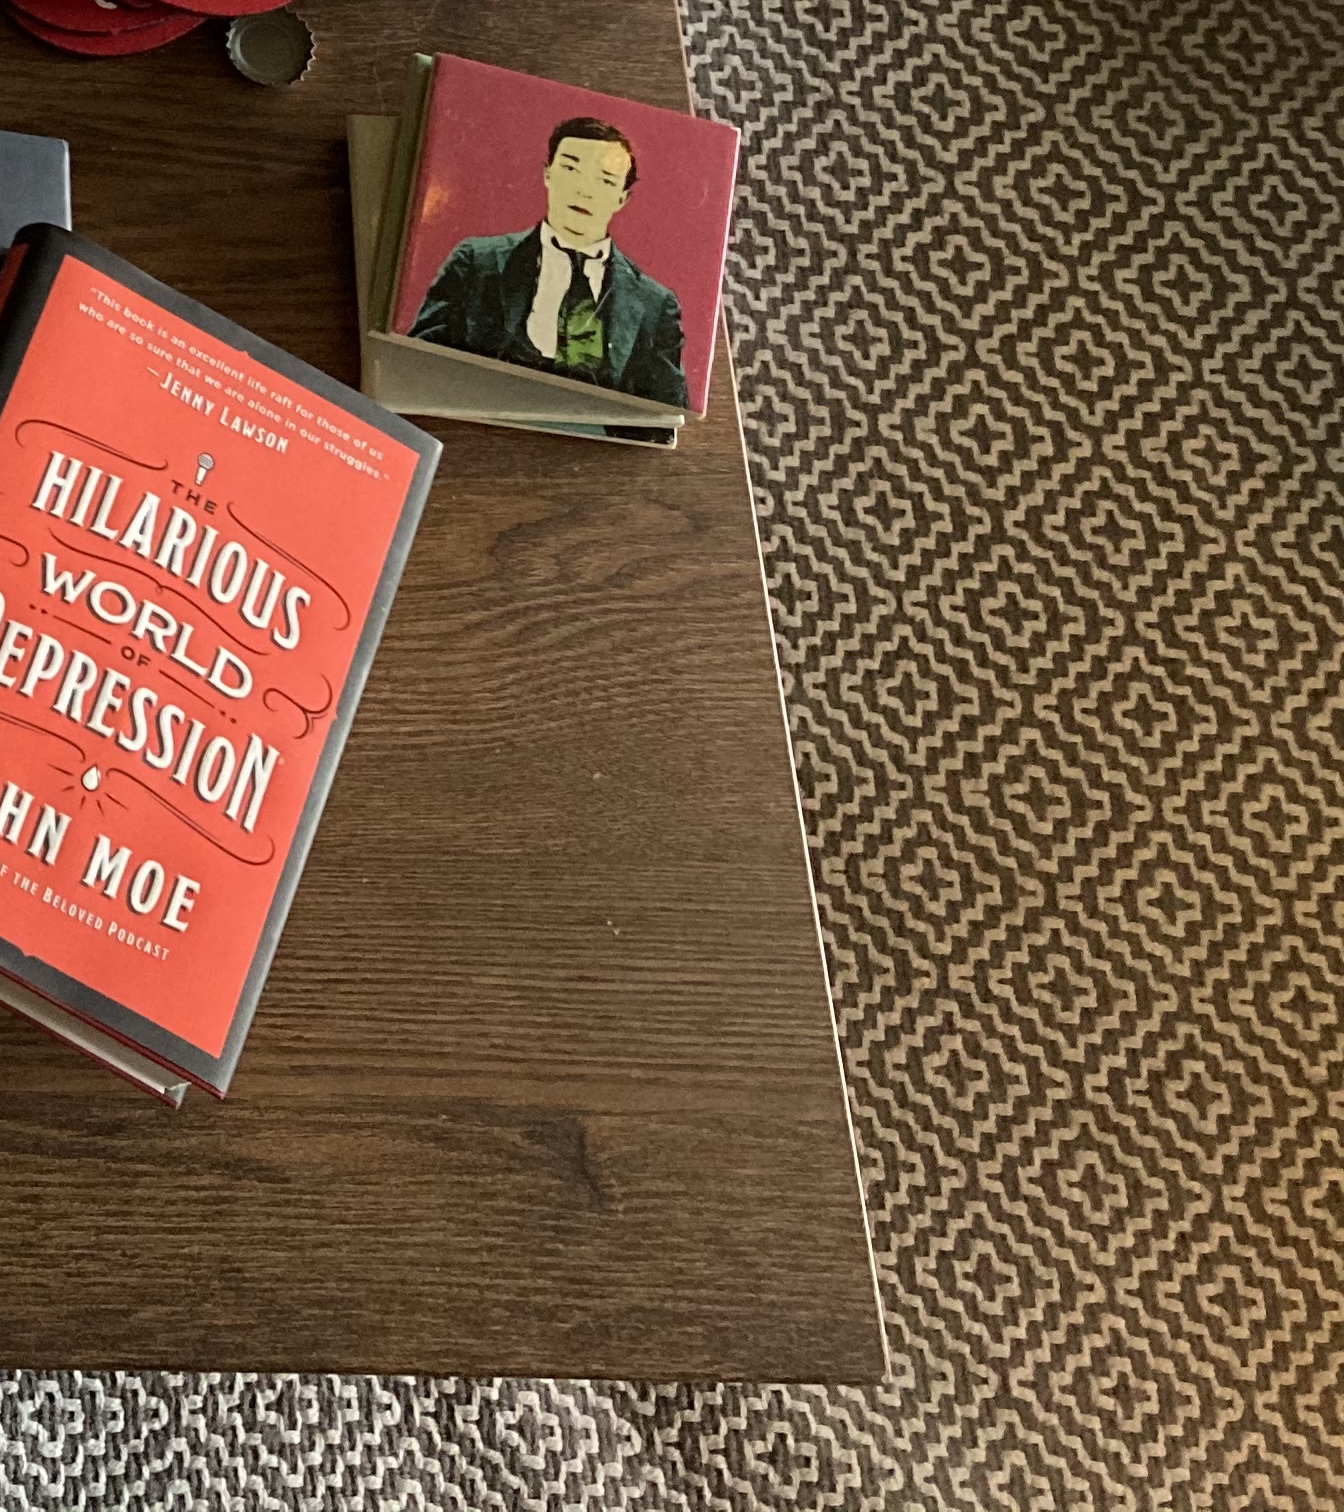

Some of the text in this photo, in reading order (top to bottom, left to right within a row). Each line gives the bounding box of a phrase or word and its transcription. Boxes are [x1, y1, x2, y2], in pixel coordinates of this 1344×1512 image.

[78, 302, 105, 322] who
[106, 319, 127, 336] are
[128, 332, 144, 345] so
[146, 342, 173, 363] sure
[176, 357, 201, 379] that
[204, 375, 222, 390] we
[224, 387, 245, 404] are
[247, 398, 282, 424] alone
[284, 417, 297, 431] in
[299, 427, 322, 445] our
[123, 306, 155, 332] book
[157, 326, 169, 339] is
[170, 335, 187, 350] an
[189, 345, 245, 382] excellent
[247, 376, 267, 394] life
[270, 391, 293, 409] raft
[295, 403, 315, 421] for
[316, 415, 351, 441] those
[353, 438, 367, 451] of
[369, 447, 384, 461] us
[219, 406, 290, 454] LAWSON
[171, 479, 217, 515] THE
[30, 450, 311, 651] HILARIOUS
[40, 552, 254, 699] WORLD
[120, 645, 151, 669] OF
[12, 871, 39, 896] THE
[42, 886, 103, 931] BELOVED
[107, 921, 170, 961] PODCAST
[80, 833, 201, 933] MOE
